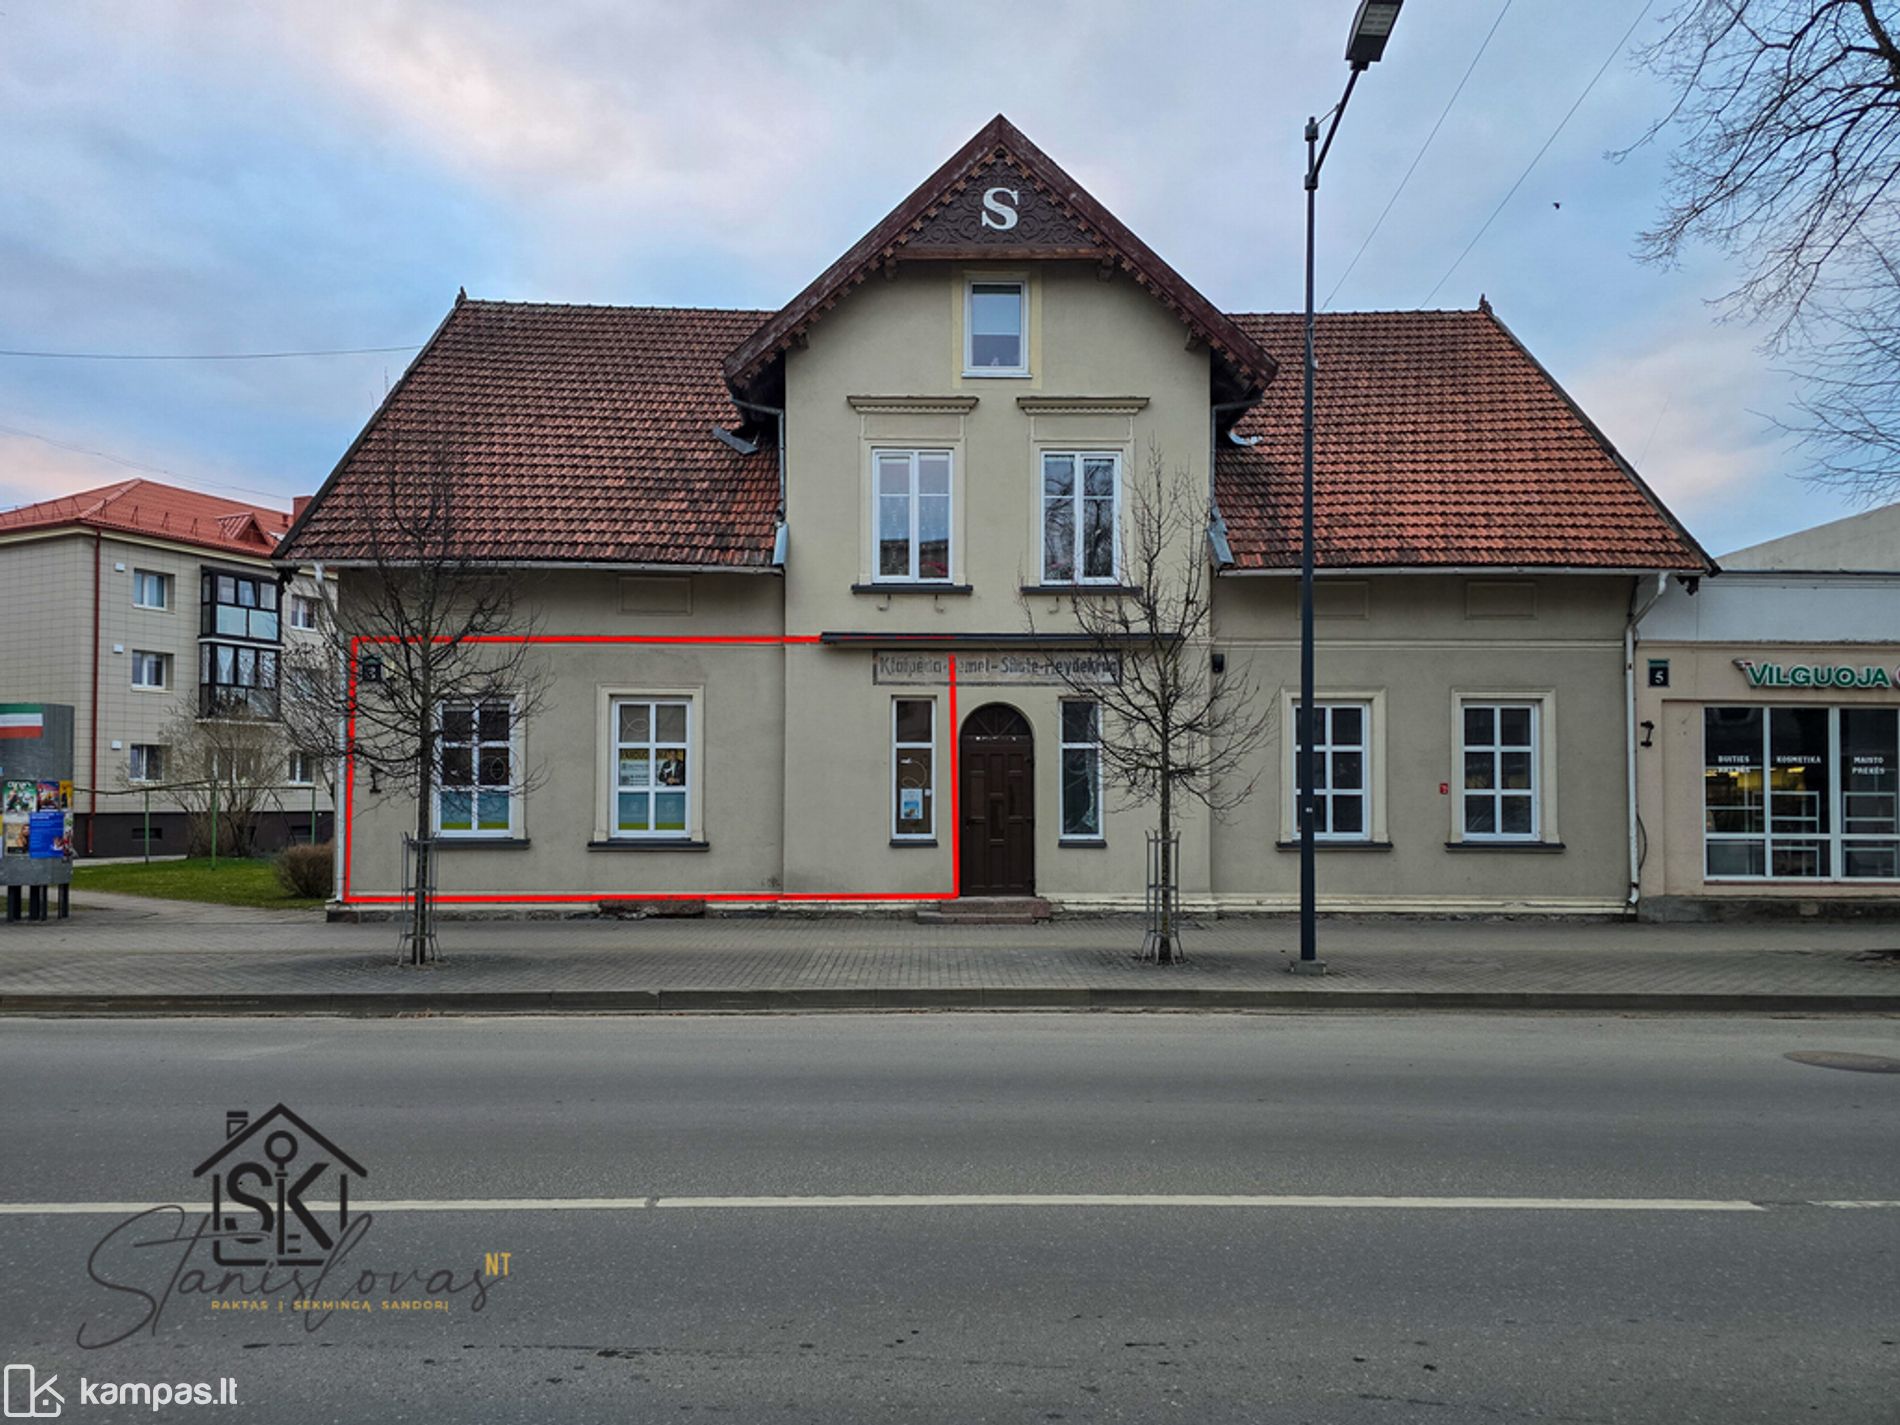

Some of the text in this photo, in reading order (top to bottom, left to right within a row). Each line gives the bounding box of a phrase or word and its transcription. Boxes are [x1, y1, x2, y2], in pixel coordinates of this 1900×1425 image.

[981, 187, 1019, 230] S
[1655, 671, 1664, 684] 5
[1748, 662, 1891, 688] VILGUOJA
[1776, 755, 1821, 764] KOSMETIKA
